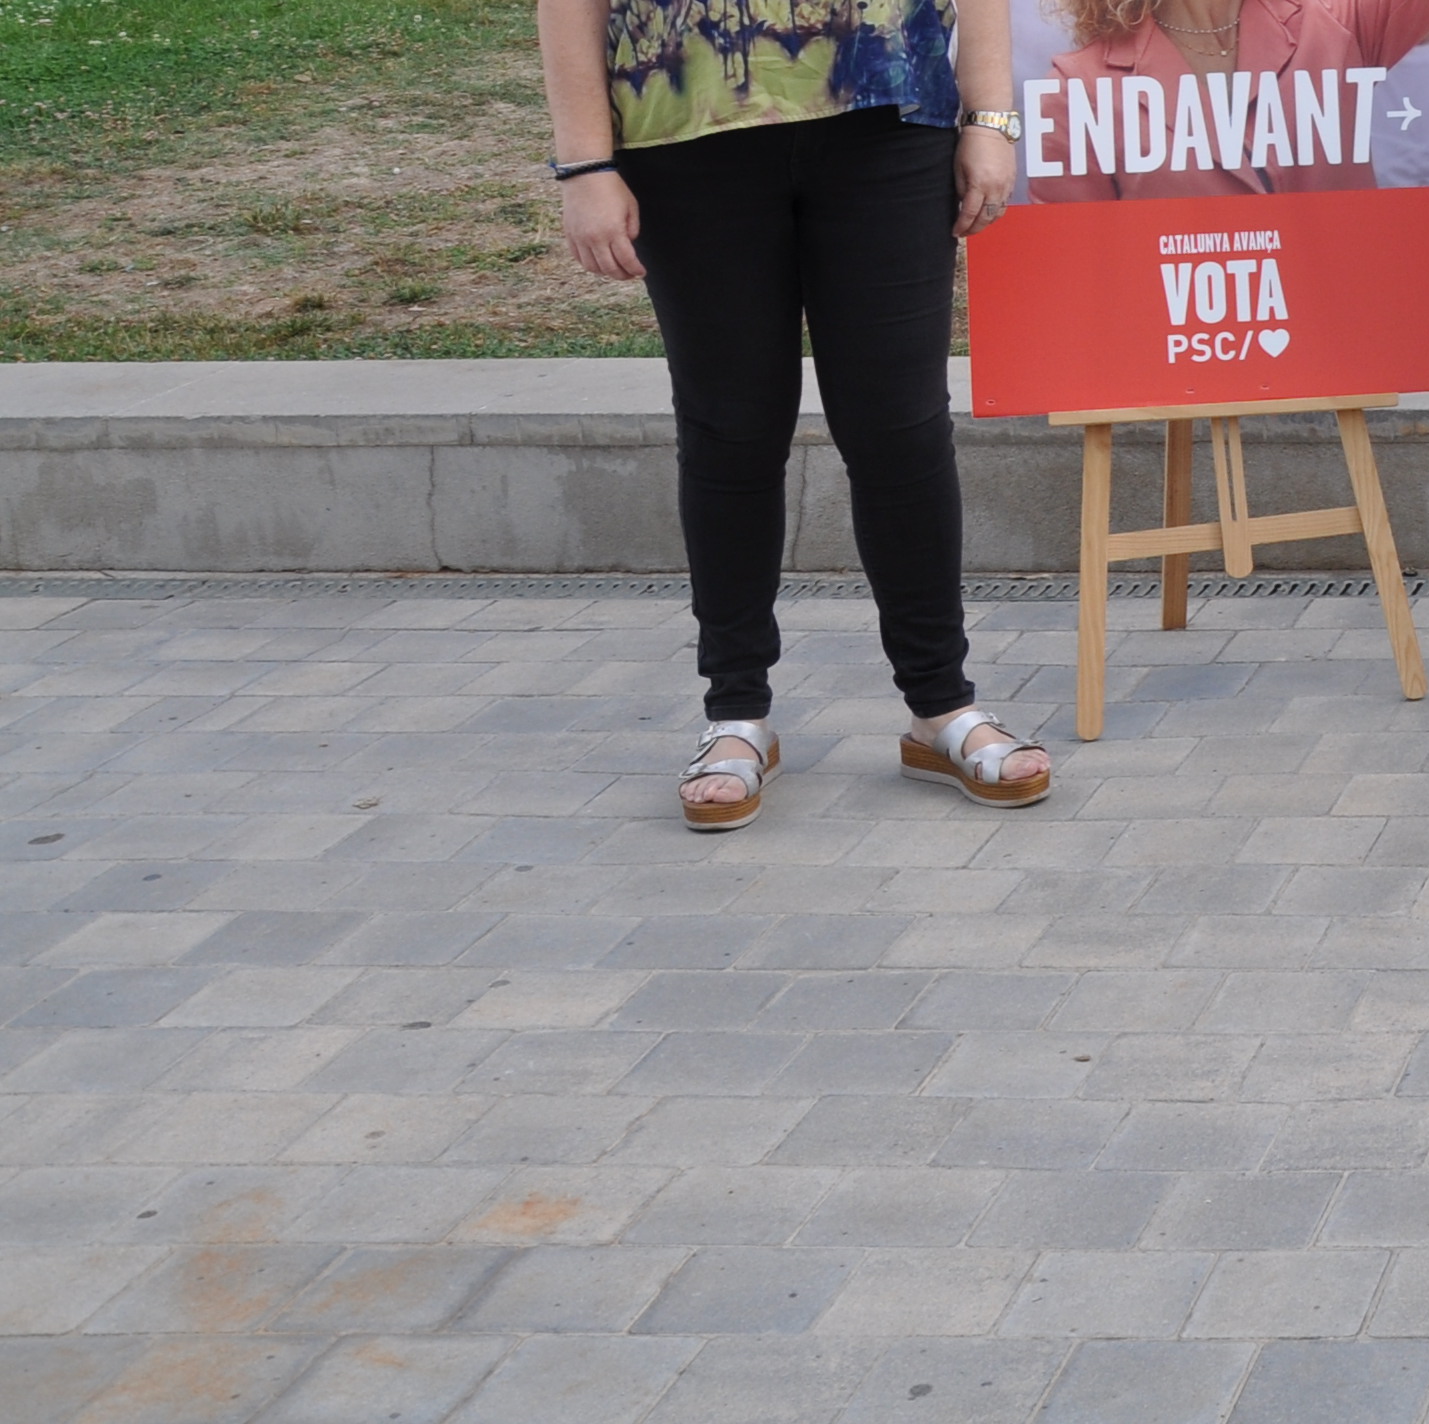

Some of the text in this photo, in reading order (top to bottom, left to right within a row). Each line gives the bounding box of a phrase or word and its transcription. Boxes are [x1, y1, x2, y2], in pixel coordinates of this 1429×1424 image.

[1023, 66, 1387, 179] ENDAVANT
[1159, 229, 1282, 255] CATALUNYA AVANÇA
[1160, 258, 1289, 326] VOTA
